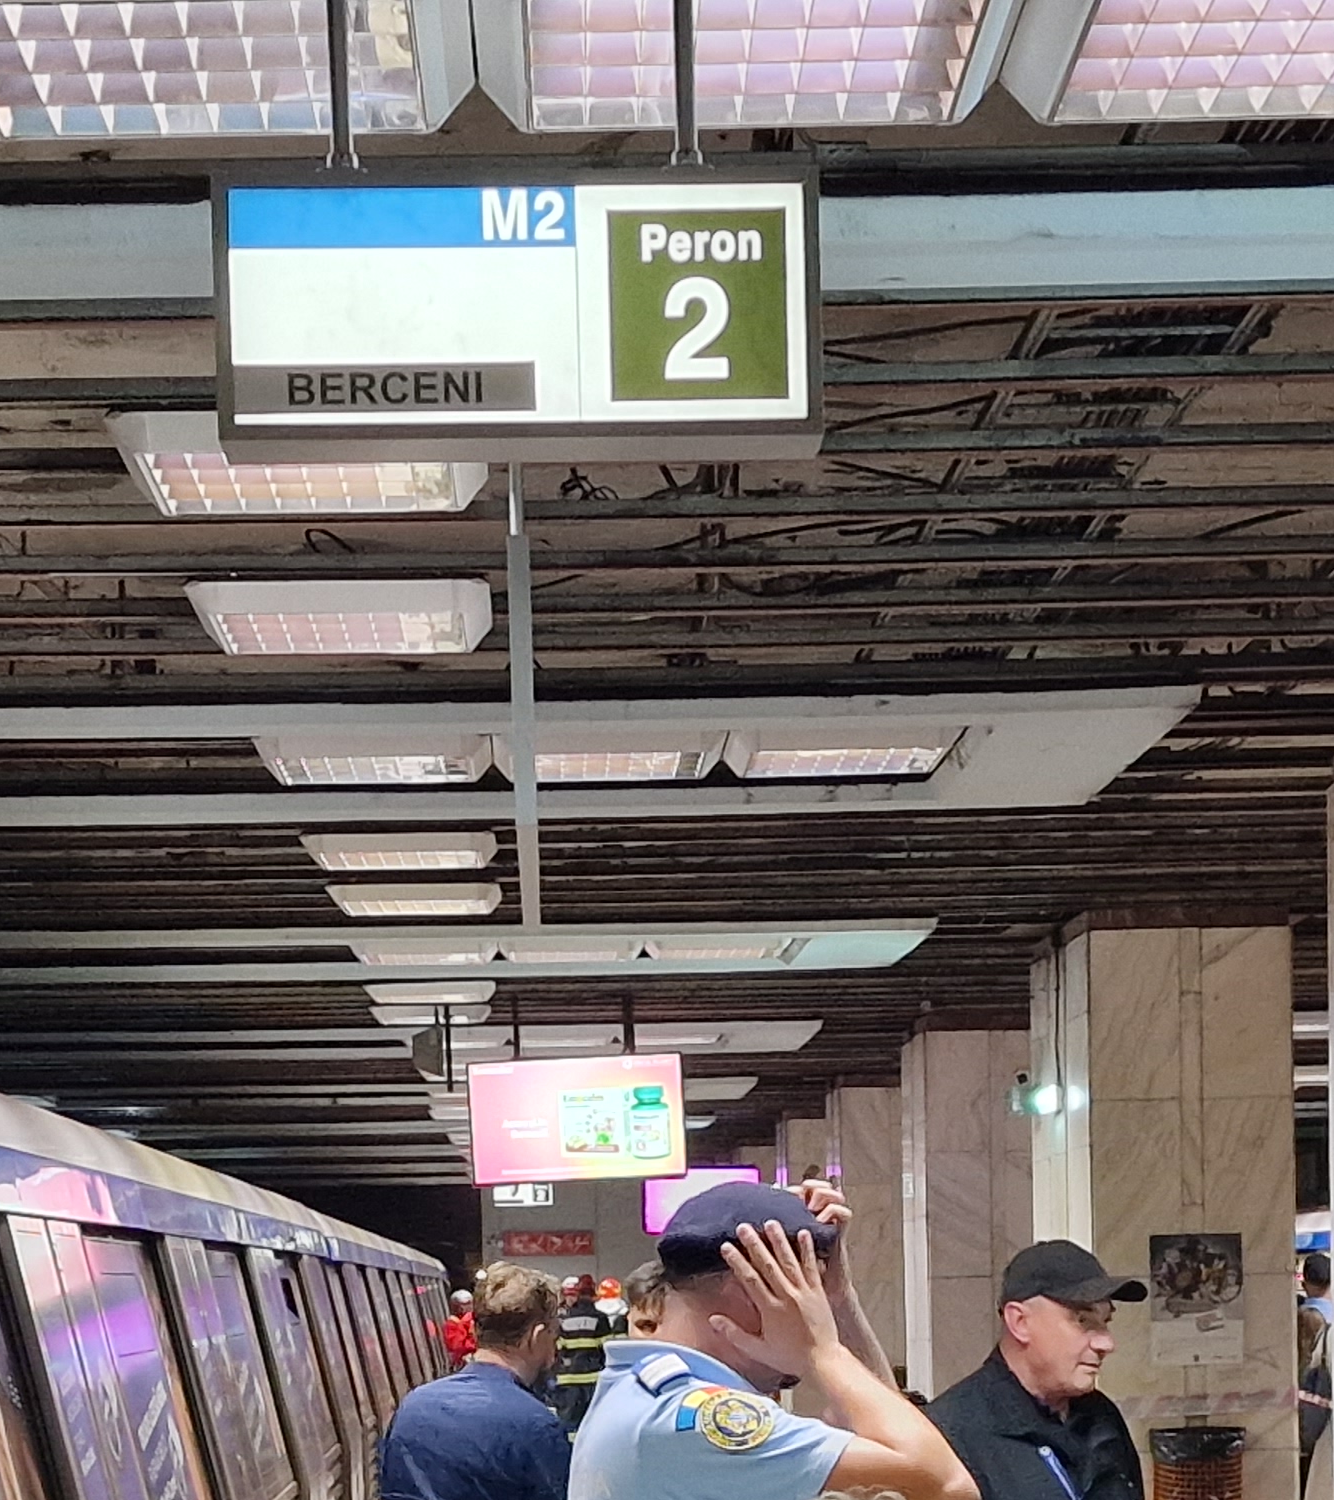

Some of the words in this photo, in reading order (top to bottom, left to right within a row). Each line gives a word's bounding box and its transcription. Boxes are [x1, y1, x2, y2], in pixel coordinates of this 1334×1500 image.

[480, 187, 566, 241] M2
[639, 222, 763, 263] Peron
[663, 275, 731, 381] 2
[286, 370, 484, 406] BERCENI
